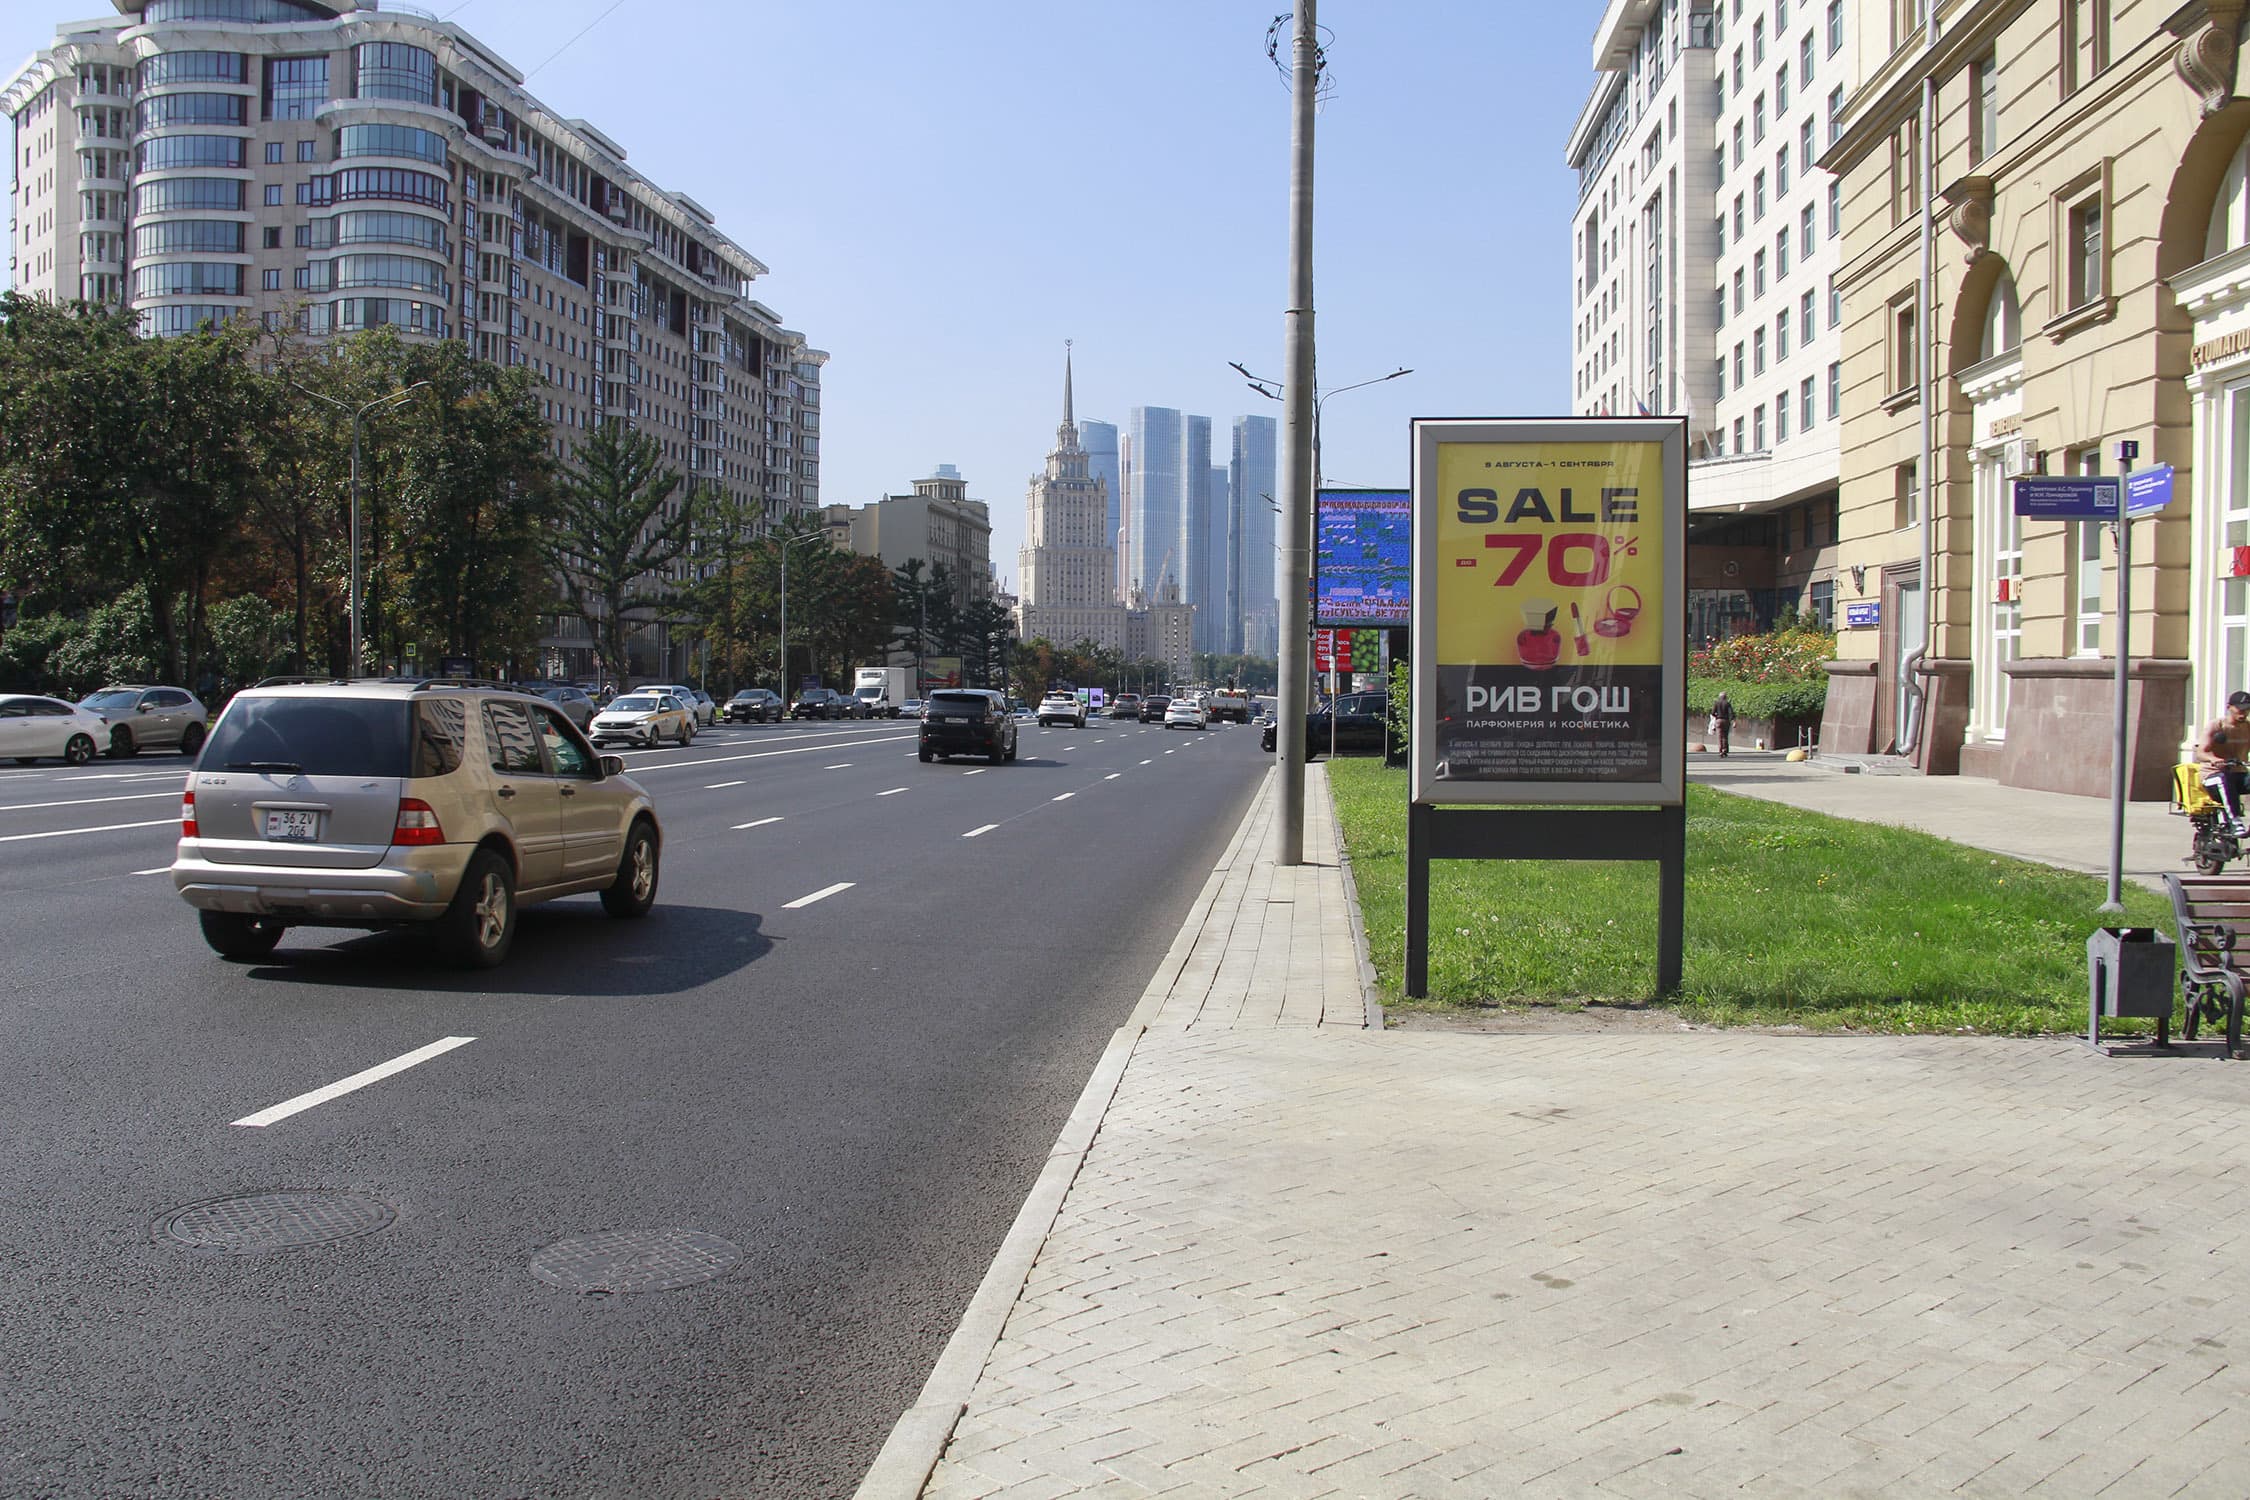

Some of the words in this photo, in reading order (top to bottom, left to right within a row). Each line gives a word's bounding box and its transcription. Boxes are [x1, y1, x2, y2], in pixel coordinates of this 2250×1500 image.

[1457, 488, 1639, 524] SALE
[1466, 686, 1542, 713] РИВ
[1551, 685, 1630, 713] ГОШ
[1466, 720, 1545, 729] ПАРФЮМЕРИЯ
[1549, 720, 1557, 728] И
[1561, 720, 1630, 728] КОСМЕТИКА
[283, 812, 296, 824] 36
[299, 813, 315, 825] ZV
